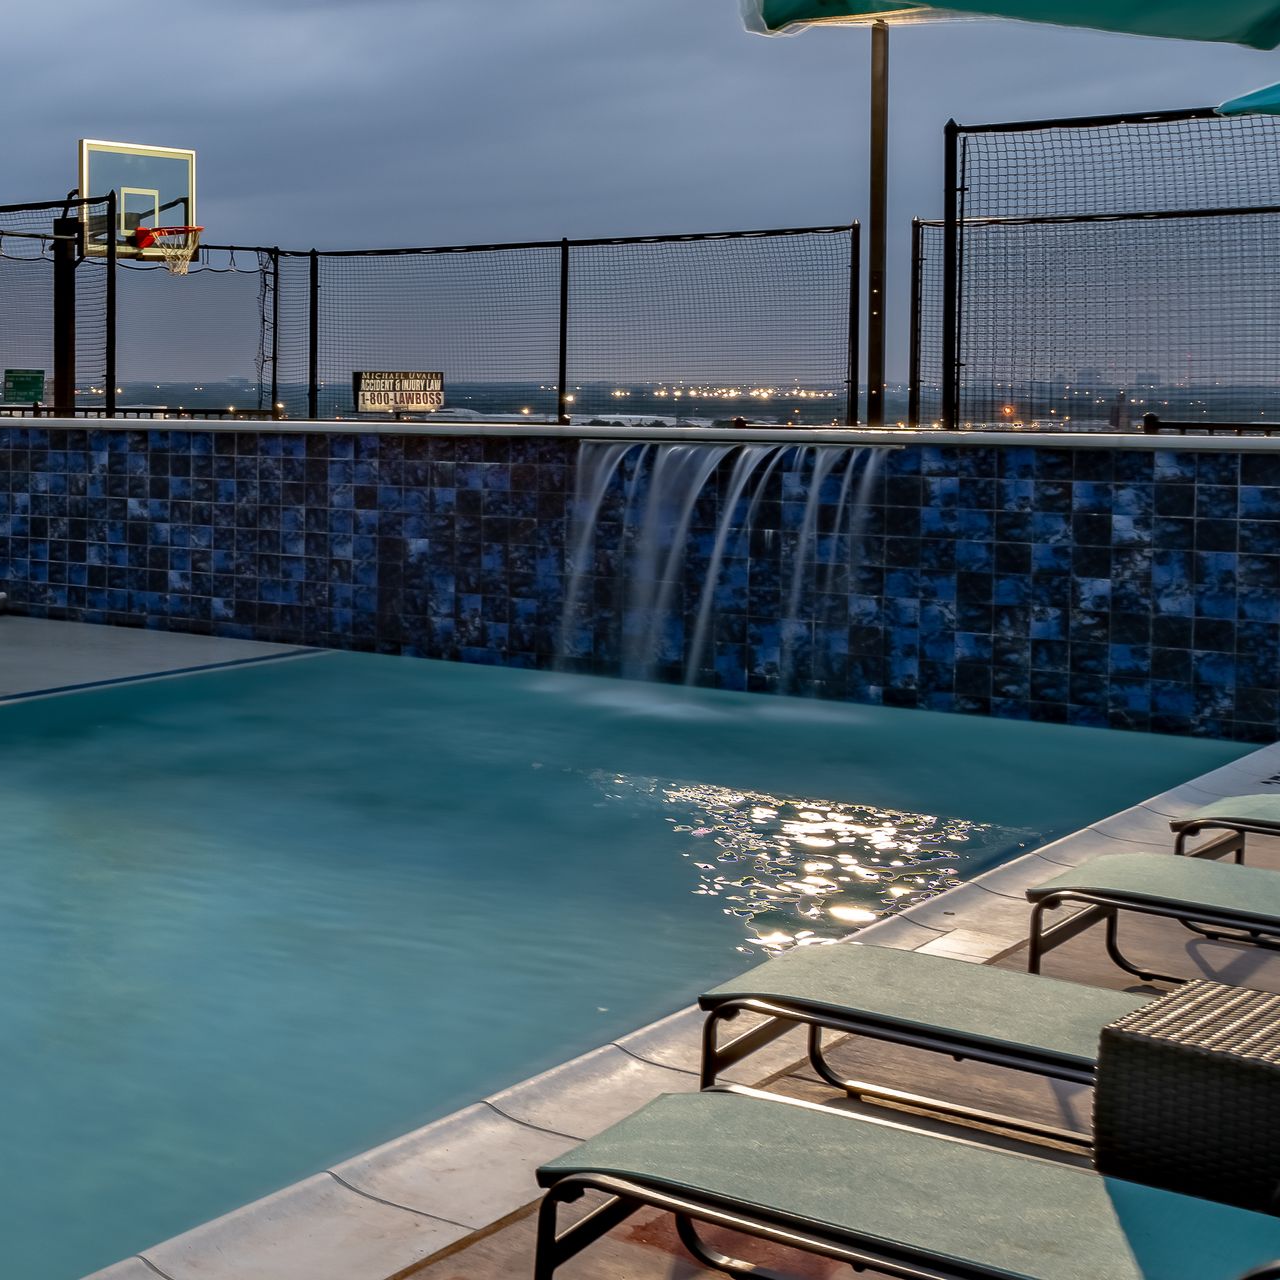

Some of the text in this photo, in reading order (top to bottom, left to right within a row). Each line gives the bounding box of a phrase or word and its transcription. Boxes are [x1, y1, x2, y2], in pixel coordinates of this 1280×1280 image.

[360, 379, 441, 391] ACCIDENT & INJURY LAW
[360, 392, 442, 405] 1-800-LAWBOSS
